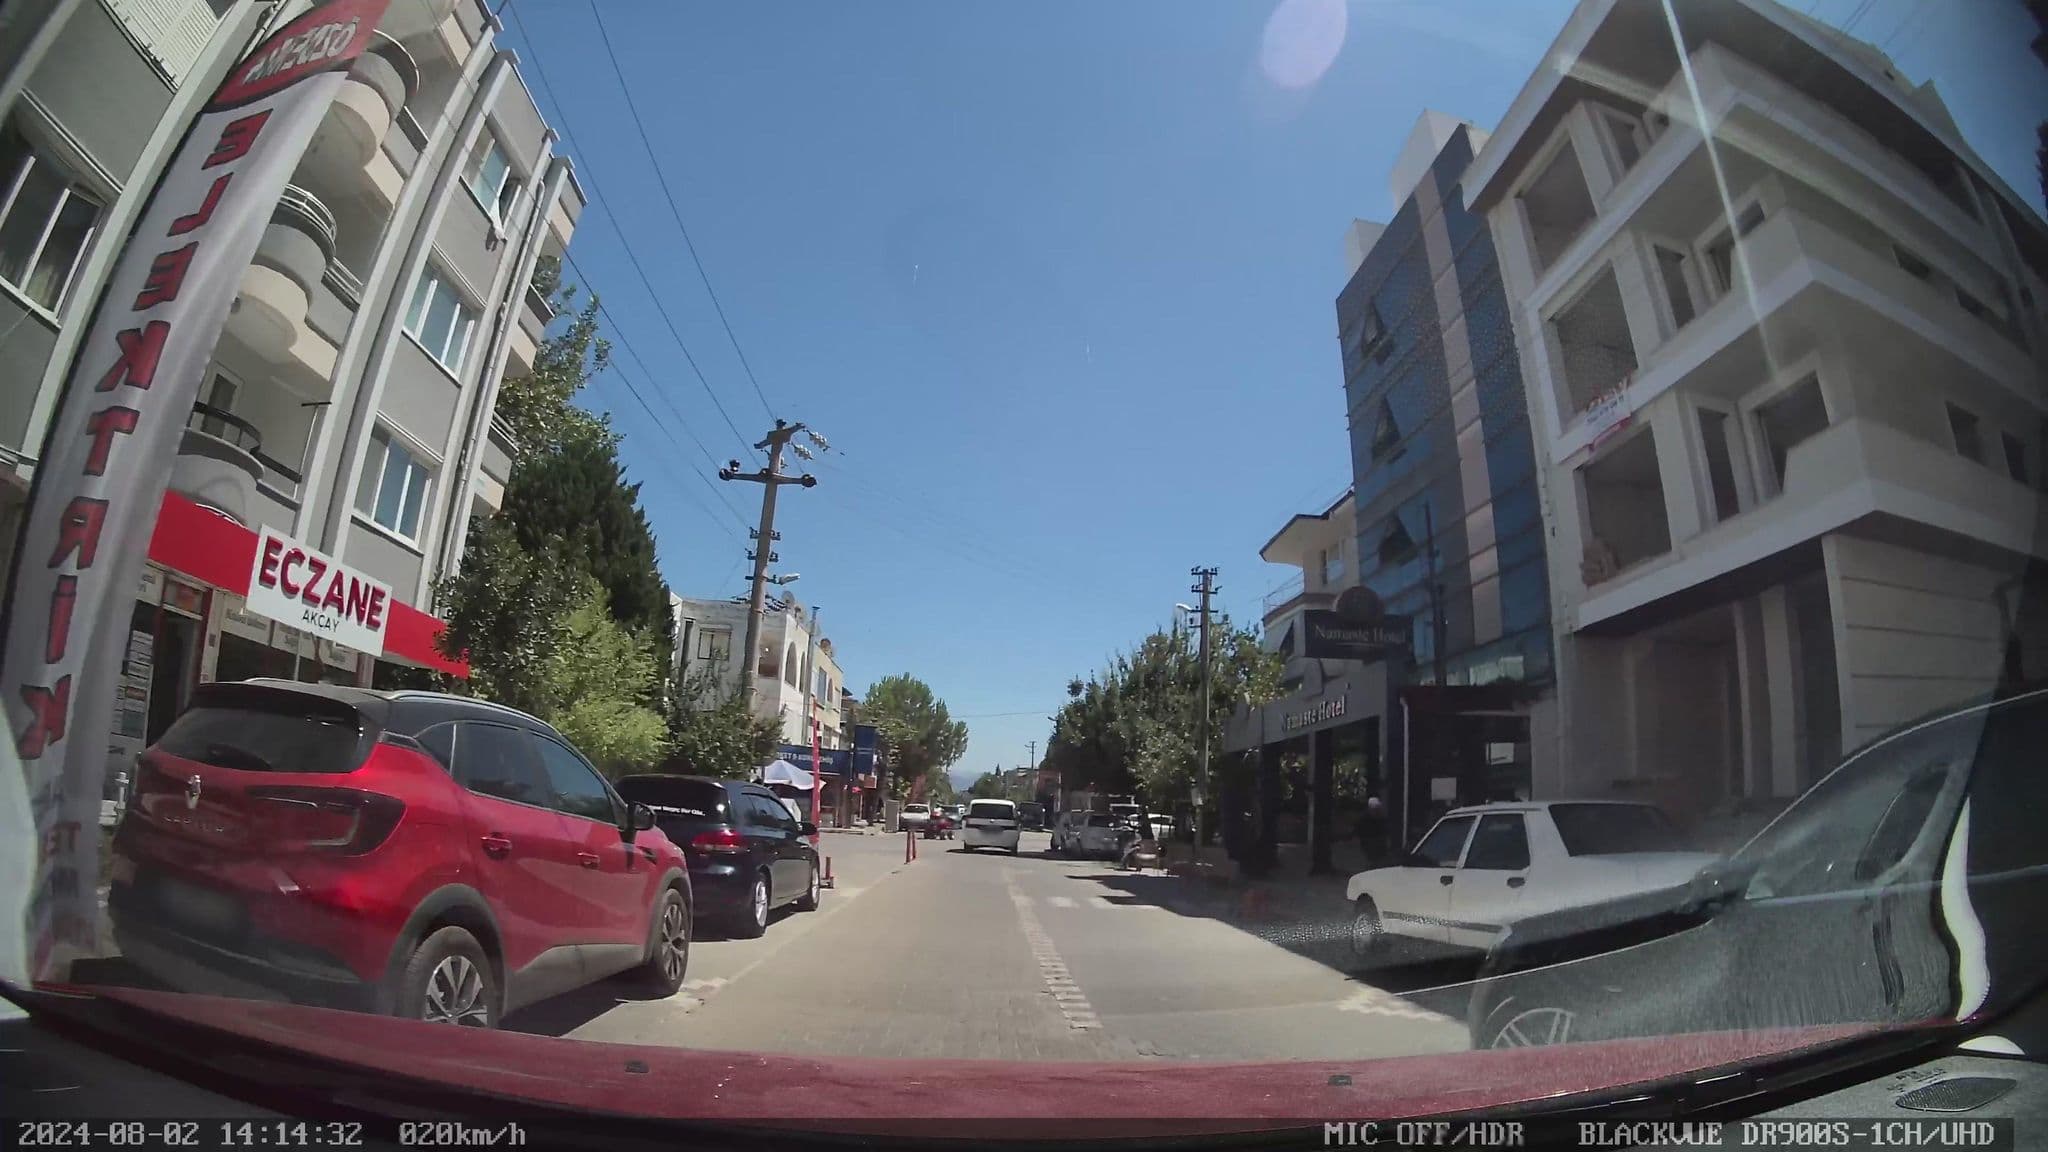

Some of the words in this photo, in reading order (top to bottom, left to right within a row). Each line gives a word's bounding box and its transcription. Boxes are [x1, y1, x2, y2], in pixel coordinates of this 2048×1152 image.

[258, 535, 386, 632] ECZANE
[1373, 626, 1407, 643] Hotel
[1318, 695, 1346, 721] Hotel
